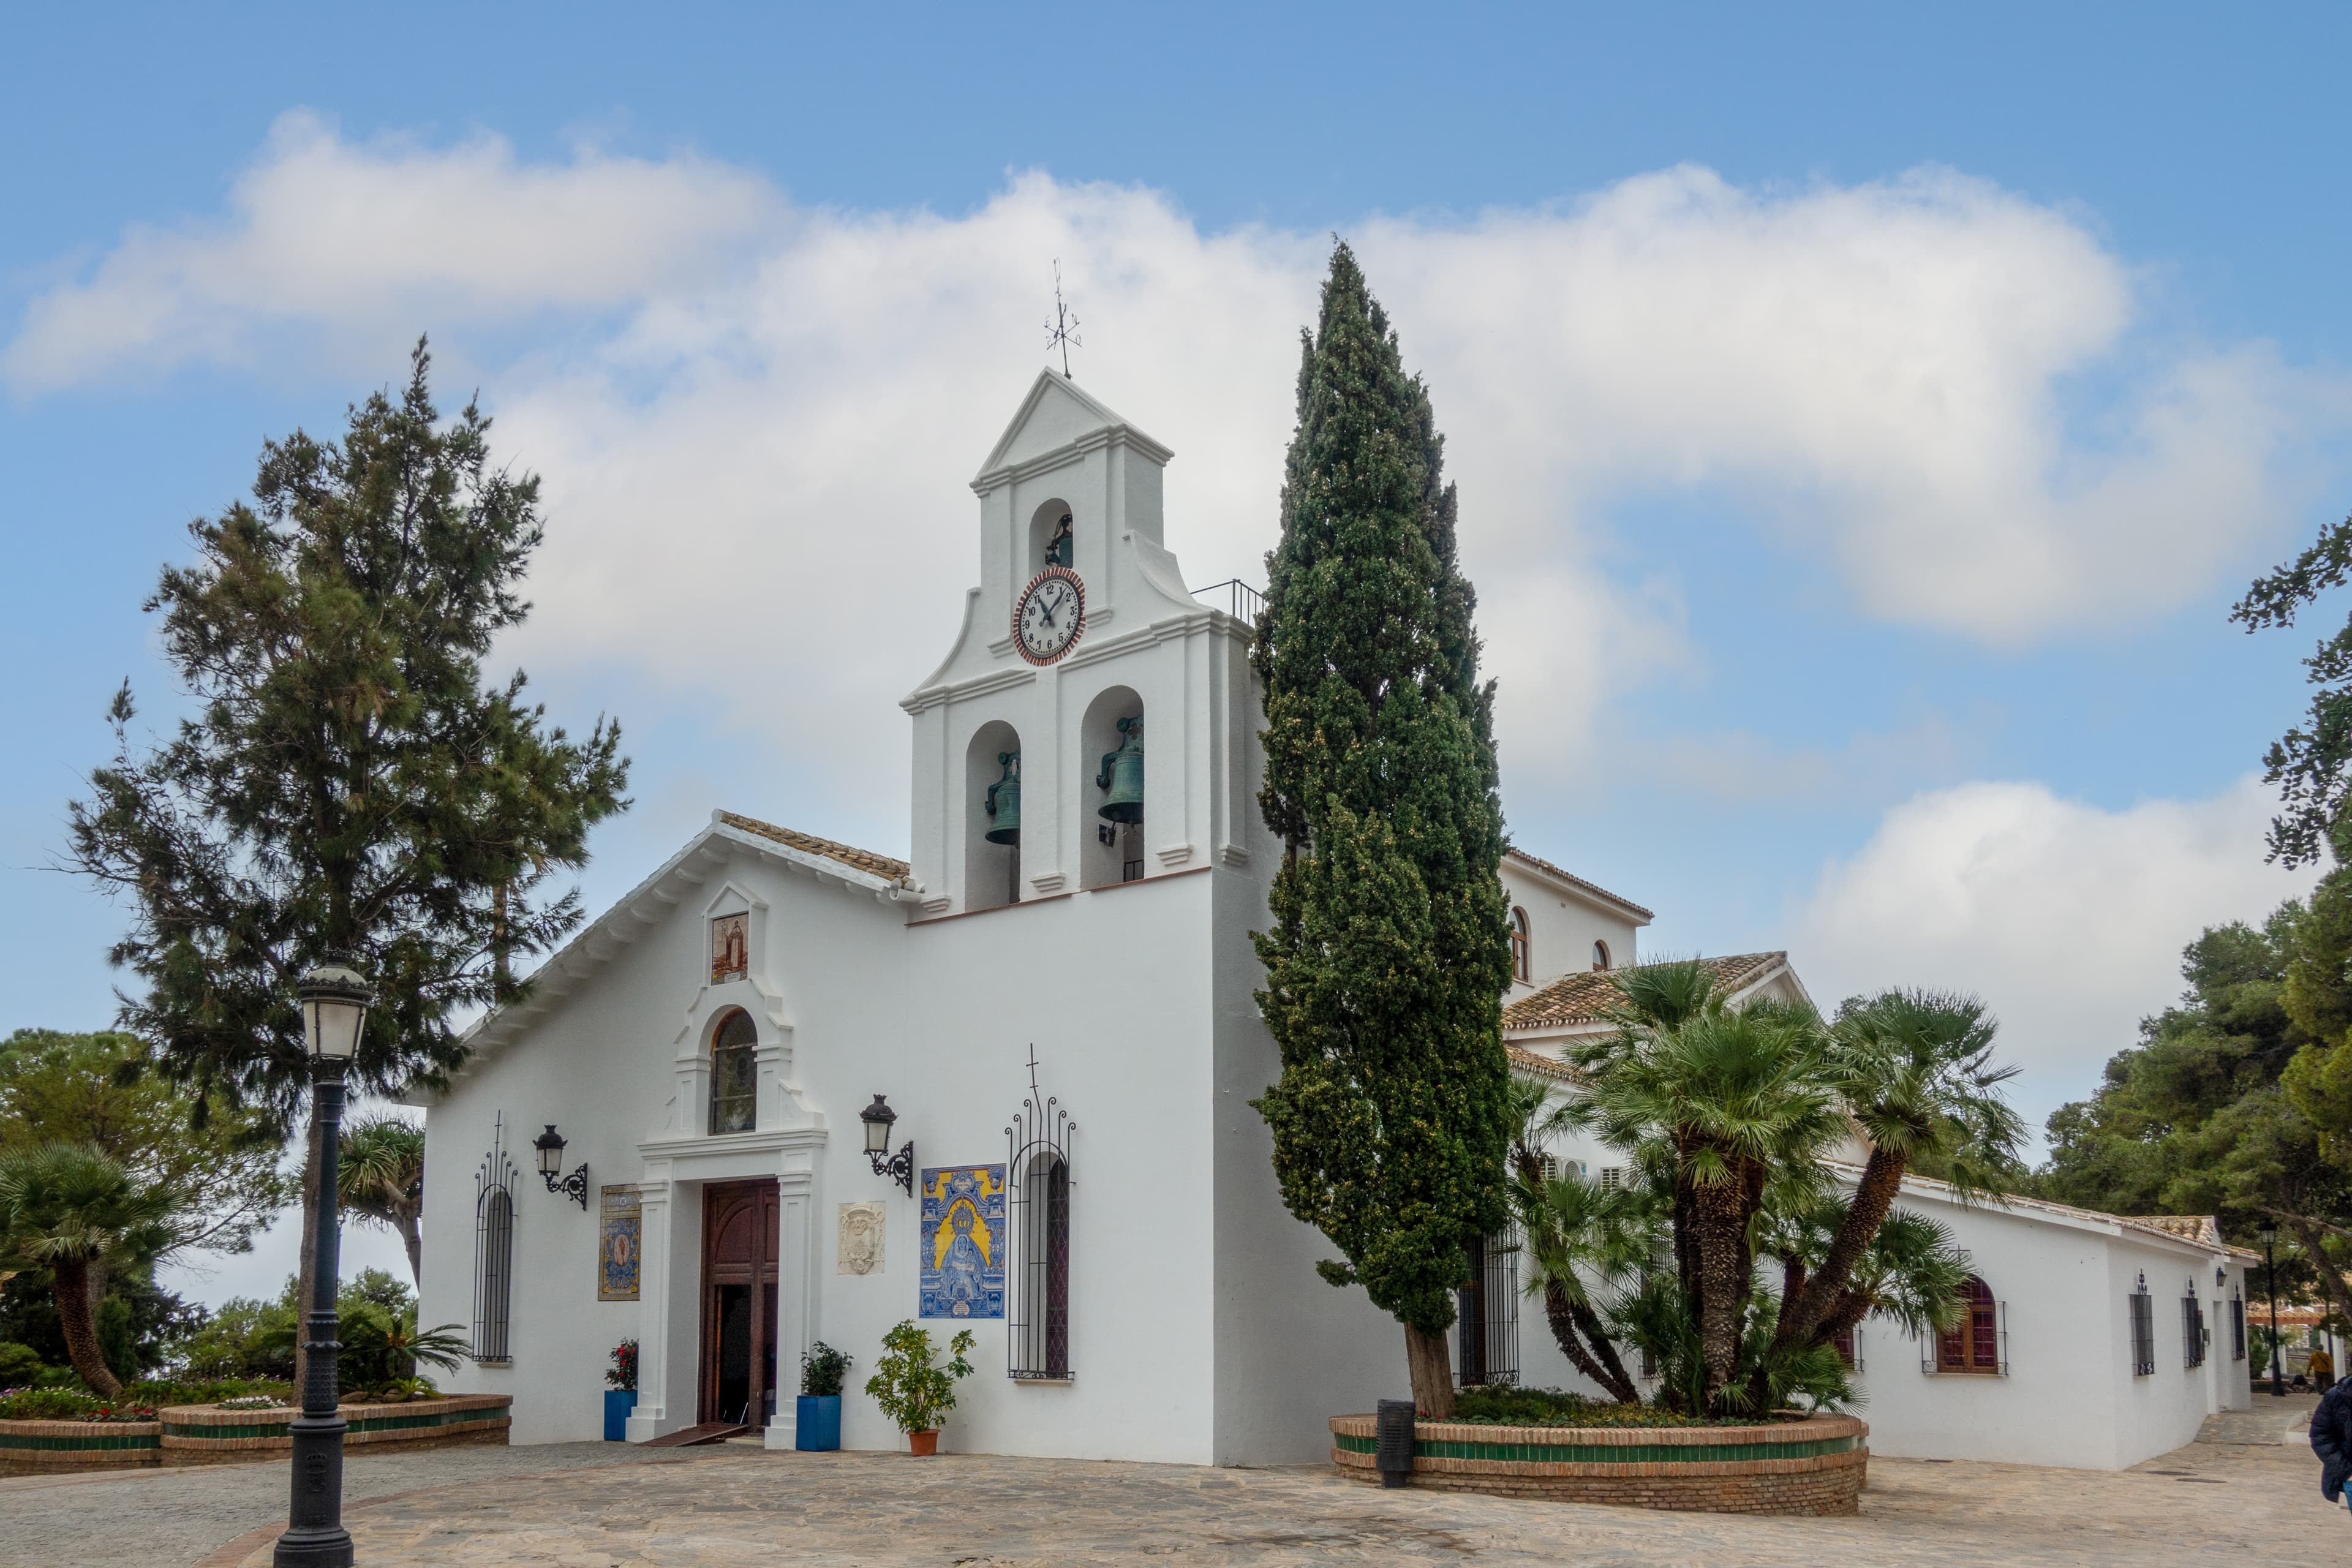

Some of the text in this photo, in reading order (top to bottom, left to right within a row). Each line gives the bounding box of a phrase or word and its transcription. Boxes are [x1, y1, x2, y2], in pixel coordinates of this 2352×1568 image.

[1046, 585, 1054, 595] 12
[1034, 594, 1040, 605] 11
[1066, 592, 1071, 603] 2
[1028, 607, 1036, 617] 10
[1070, 606, 1075, 616] 3
[1025, 620, 1030, 629] 9
[1066, 621, 1071, 630] 4
[1029, 633, 1033, 643] 8
[1058, 632, 1063, 642] 5
[1037, 640, 1041, 649] 7
[1047, 639, 1052, 649] 6
